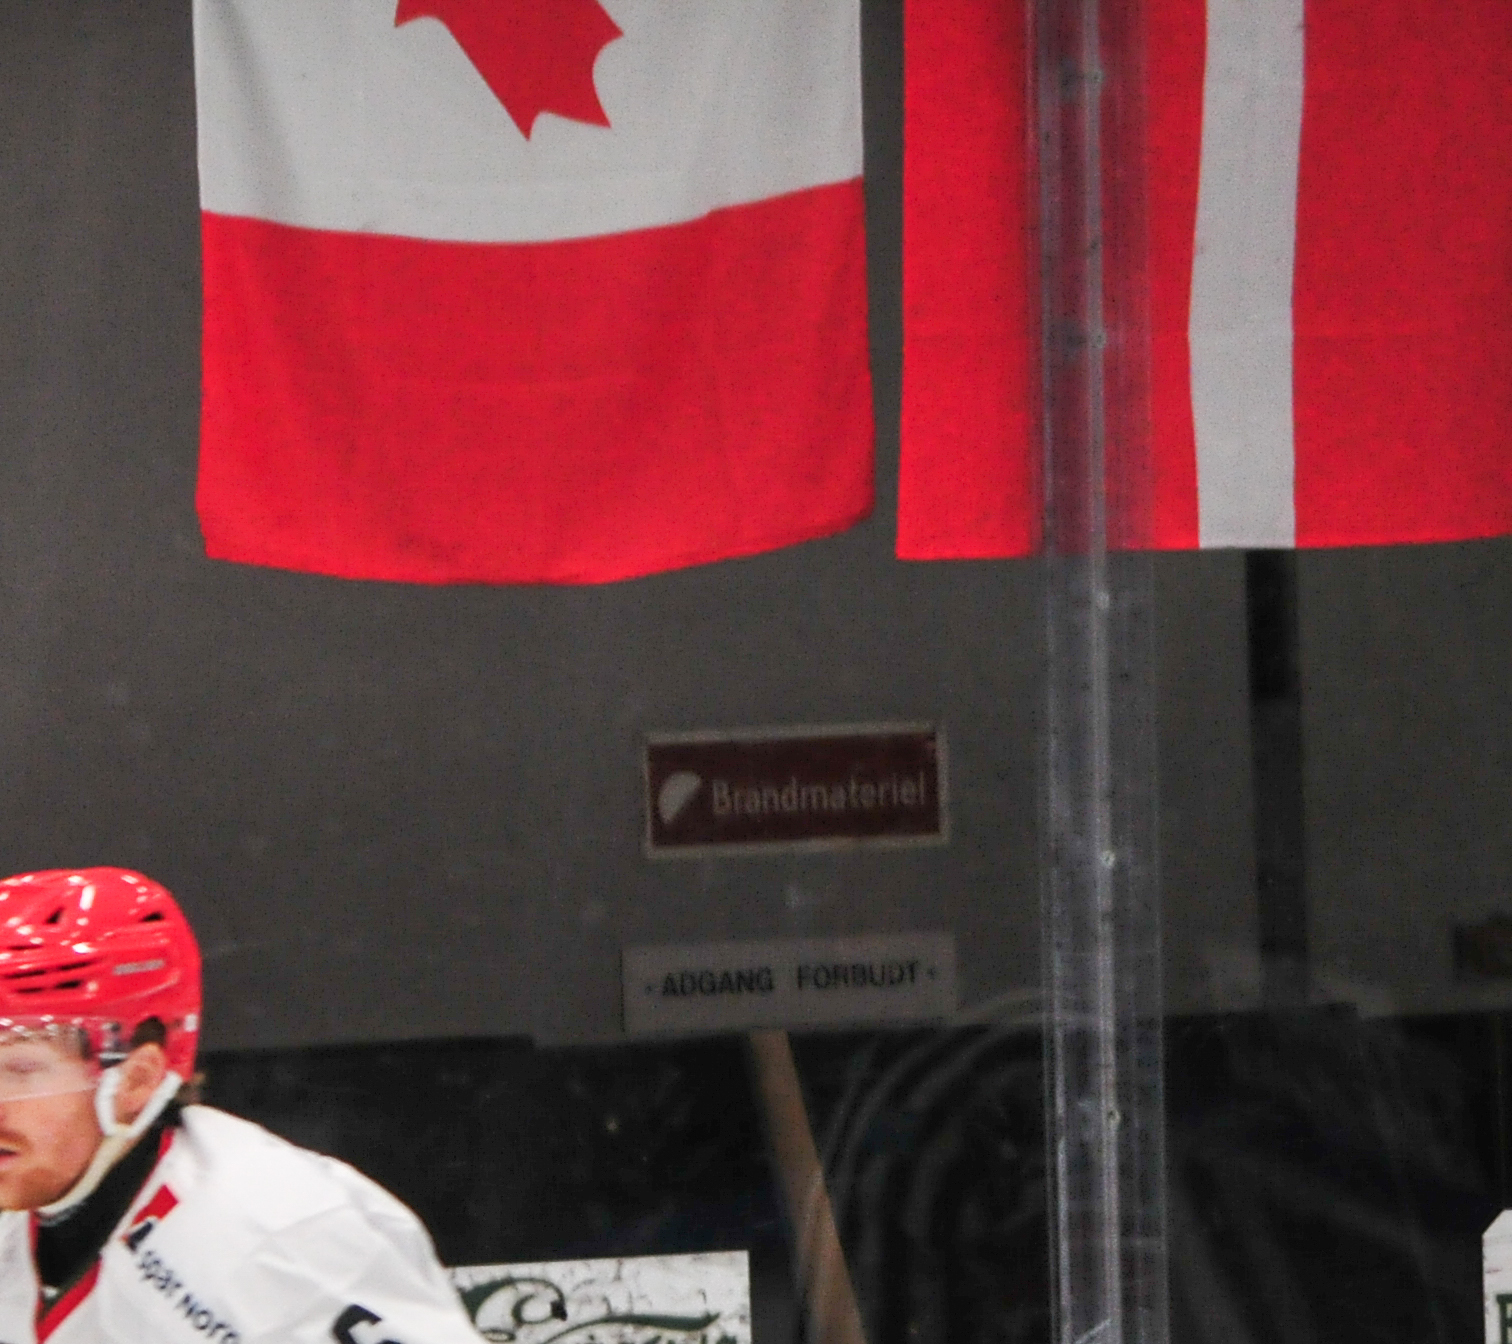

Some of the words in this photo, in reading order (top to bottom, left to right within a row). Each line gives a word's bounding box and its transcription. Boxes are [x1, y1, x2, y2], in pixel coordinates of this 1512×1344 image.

[713, 771, 925, 815] Brandmateriel
[663, 965, 774, 997] ADGANG
[797, 960, 918, 990] FORBUDT
